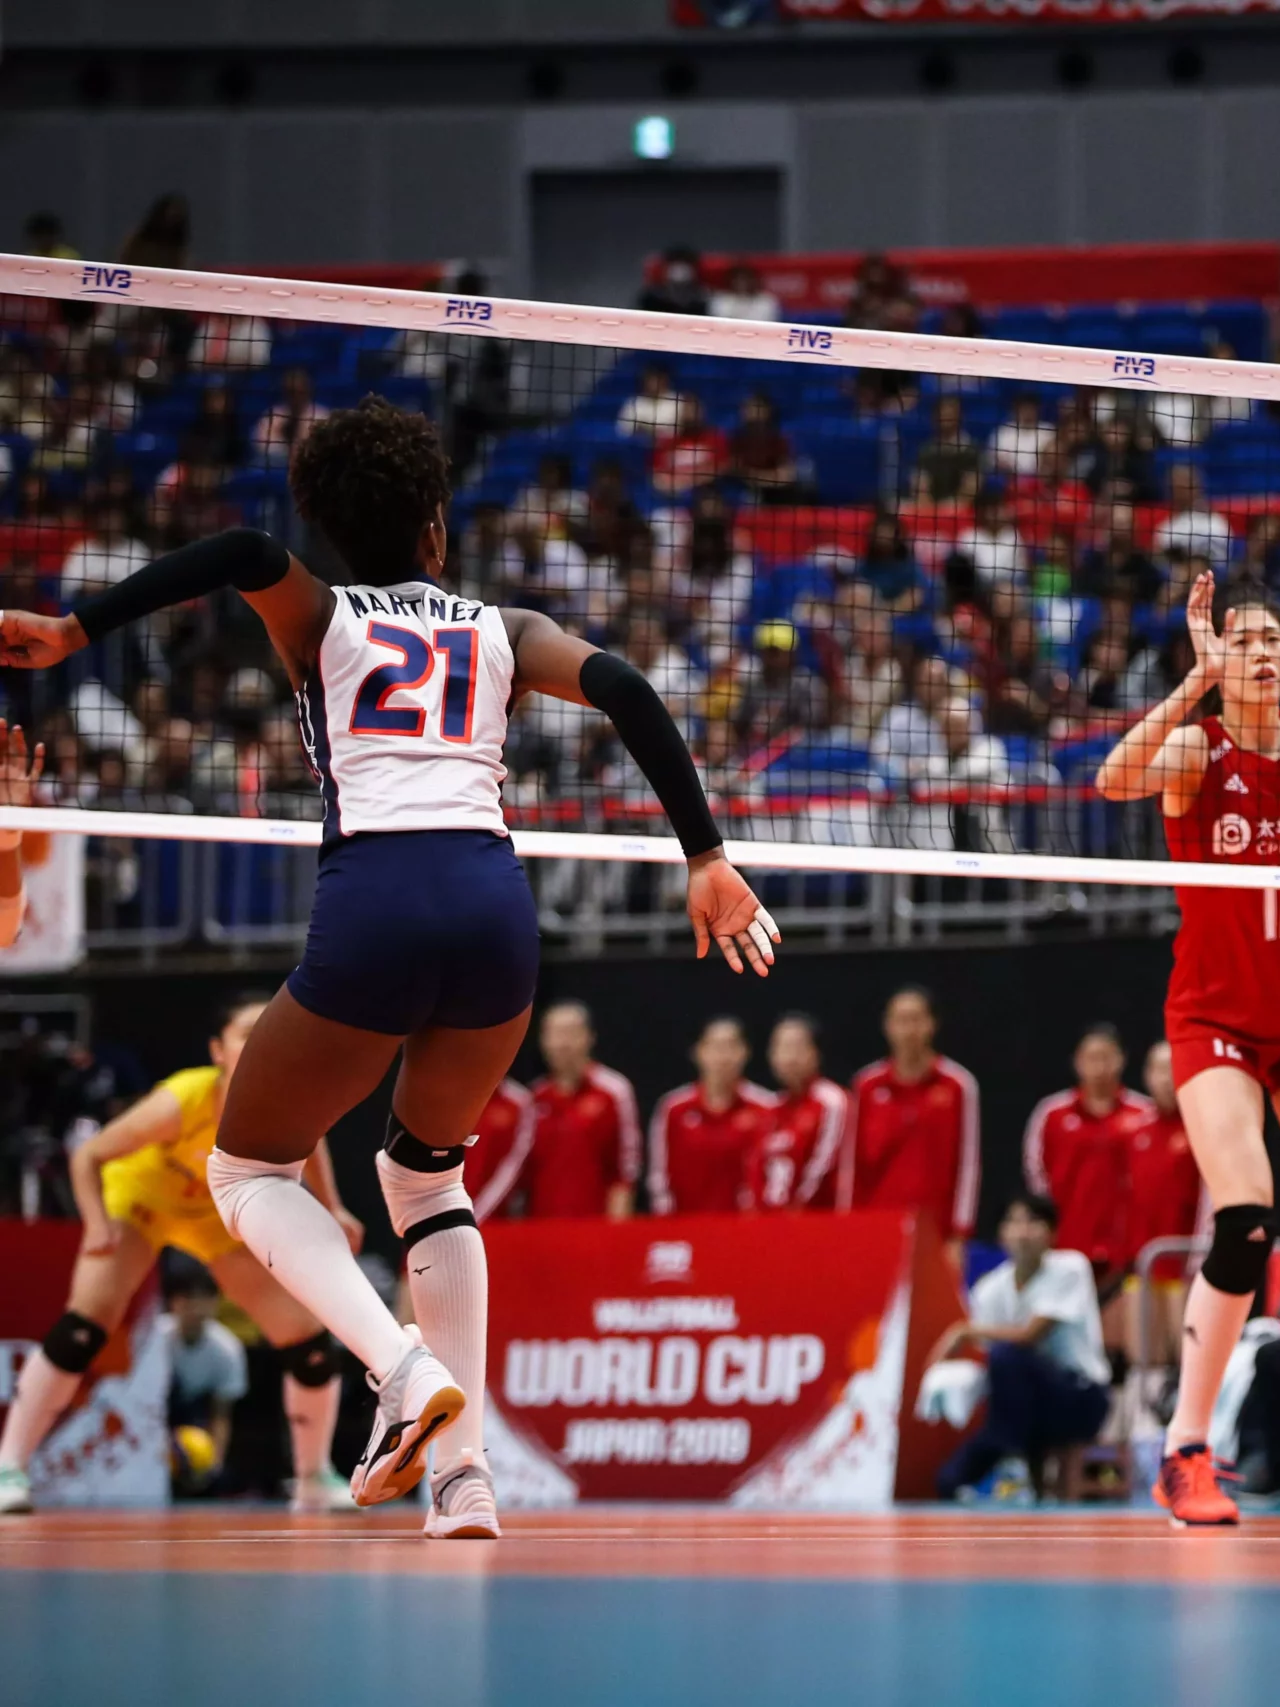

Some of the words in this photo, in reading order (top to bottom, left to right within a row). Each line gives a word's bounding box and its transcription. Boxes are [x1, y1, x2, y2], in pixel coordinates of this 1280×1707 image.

[83, 266, 132, 288] FIVB
[446, 299, 492, 320] FIVB
[789, 329, 833, 349] FIVB
[1114, 356, 1155, 376] FIVB
[349, 620, 479, 744] 21
[505, 1337, 699, 1407] WORLD
[703, 1335, 825, 1406] CUP
